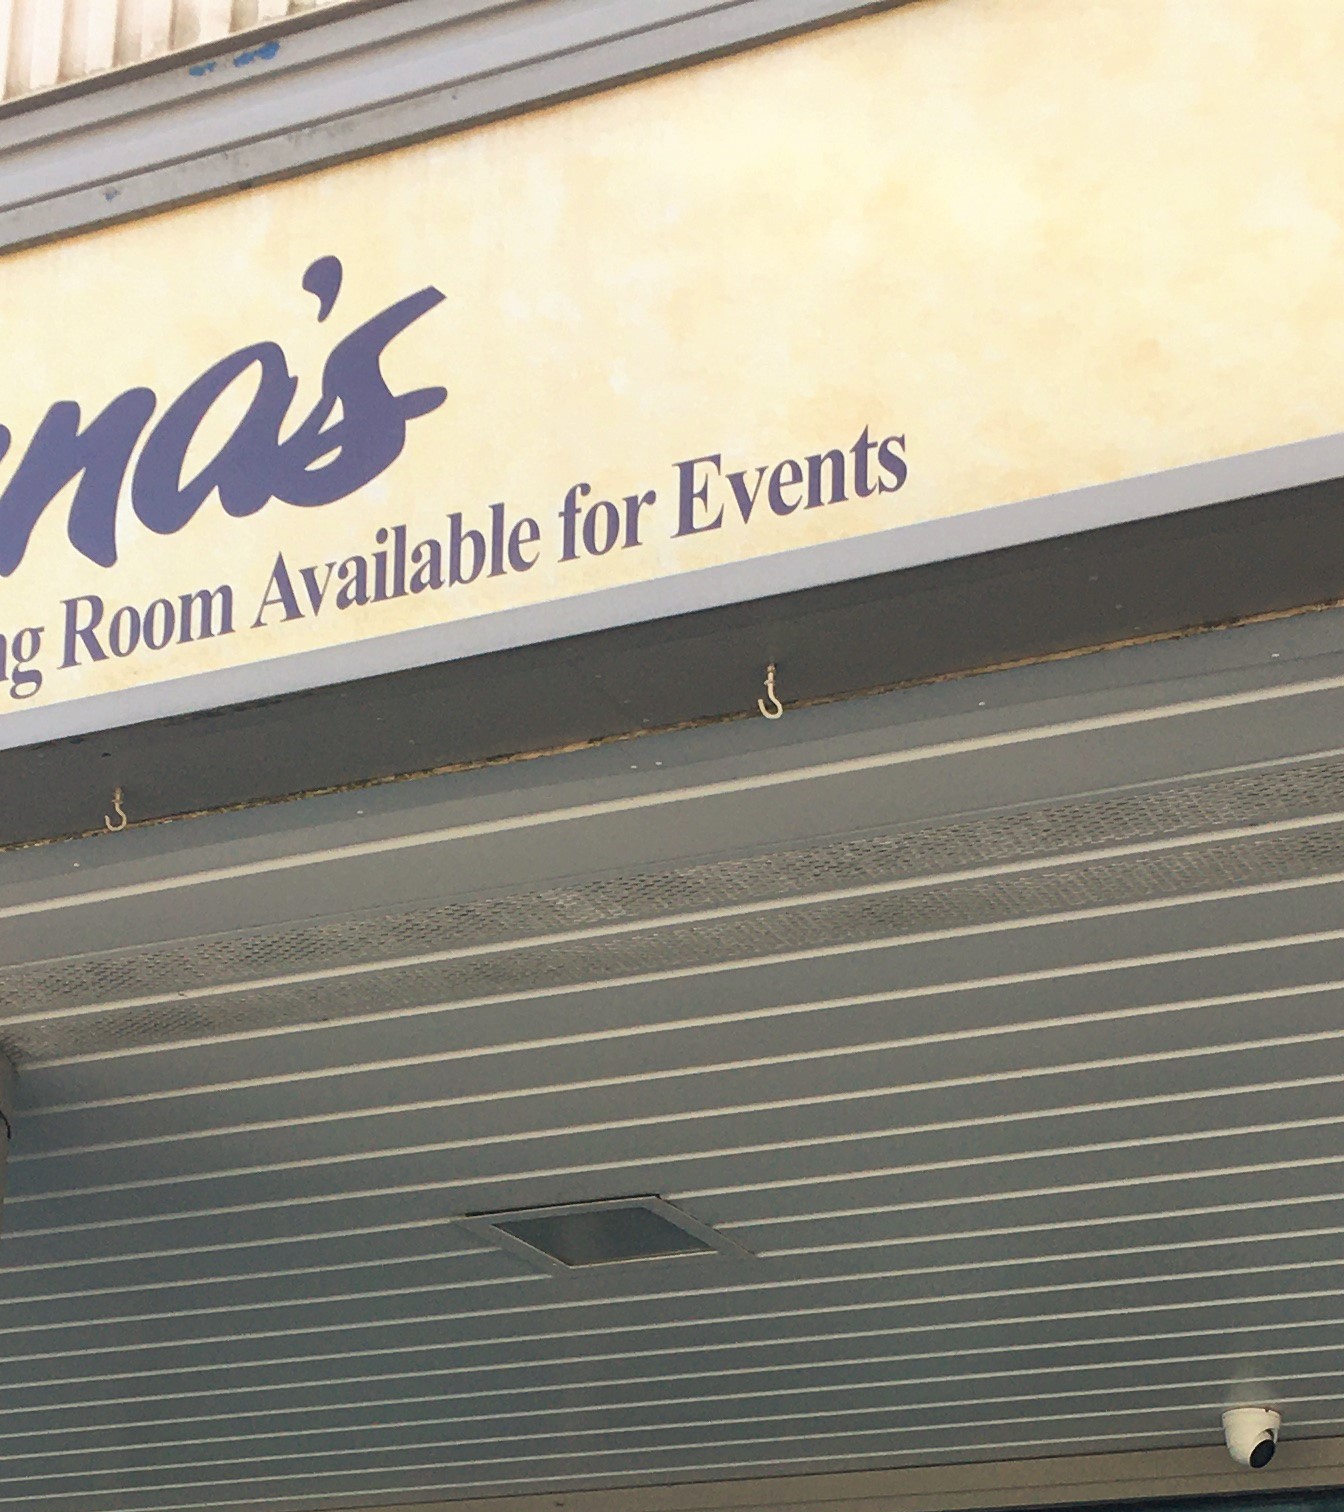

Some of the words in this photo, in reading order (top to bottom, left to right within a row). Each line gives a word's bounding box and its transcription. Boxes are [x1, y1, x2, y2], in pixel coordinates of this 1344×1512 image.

[58, 582, 234, 669] Room
[251, 502, 541, 628] Available
[558, 483, 657, 563] for
[670, 424, 908, 540] Events
